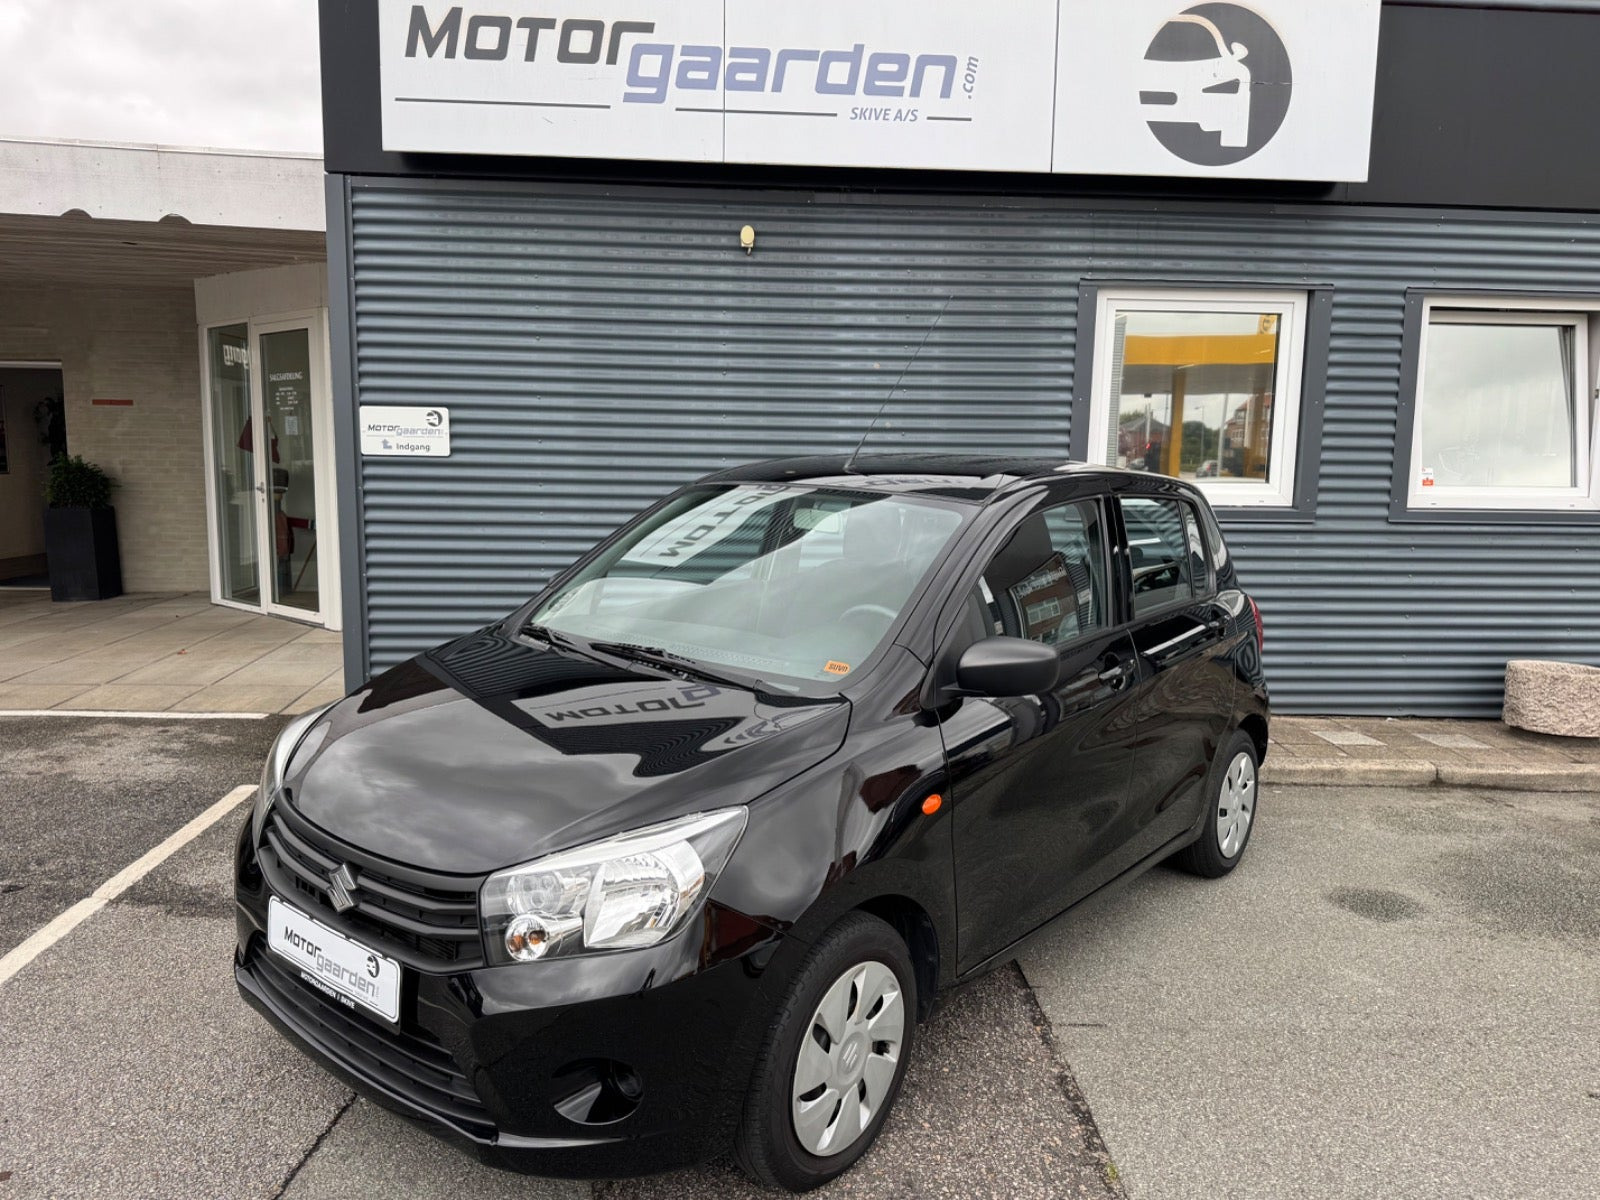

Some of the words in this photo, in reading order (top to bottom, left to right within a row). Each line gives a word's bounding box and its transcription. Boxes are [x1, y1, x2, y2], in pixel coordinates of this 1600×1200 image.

[962, 55, 979, 100] .com
[849, 106, 892, 121] SKIVE
[892, 107, 919, 122] A/S
[396, 442, 431, 453] Indgang
